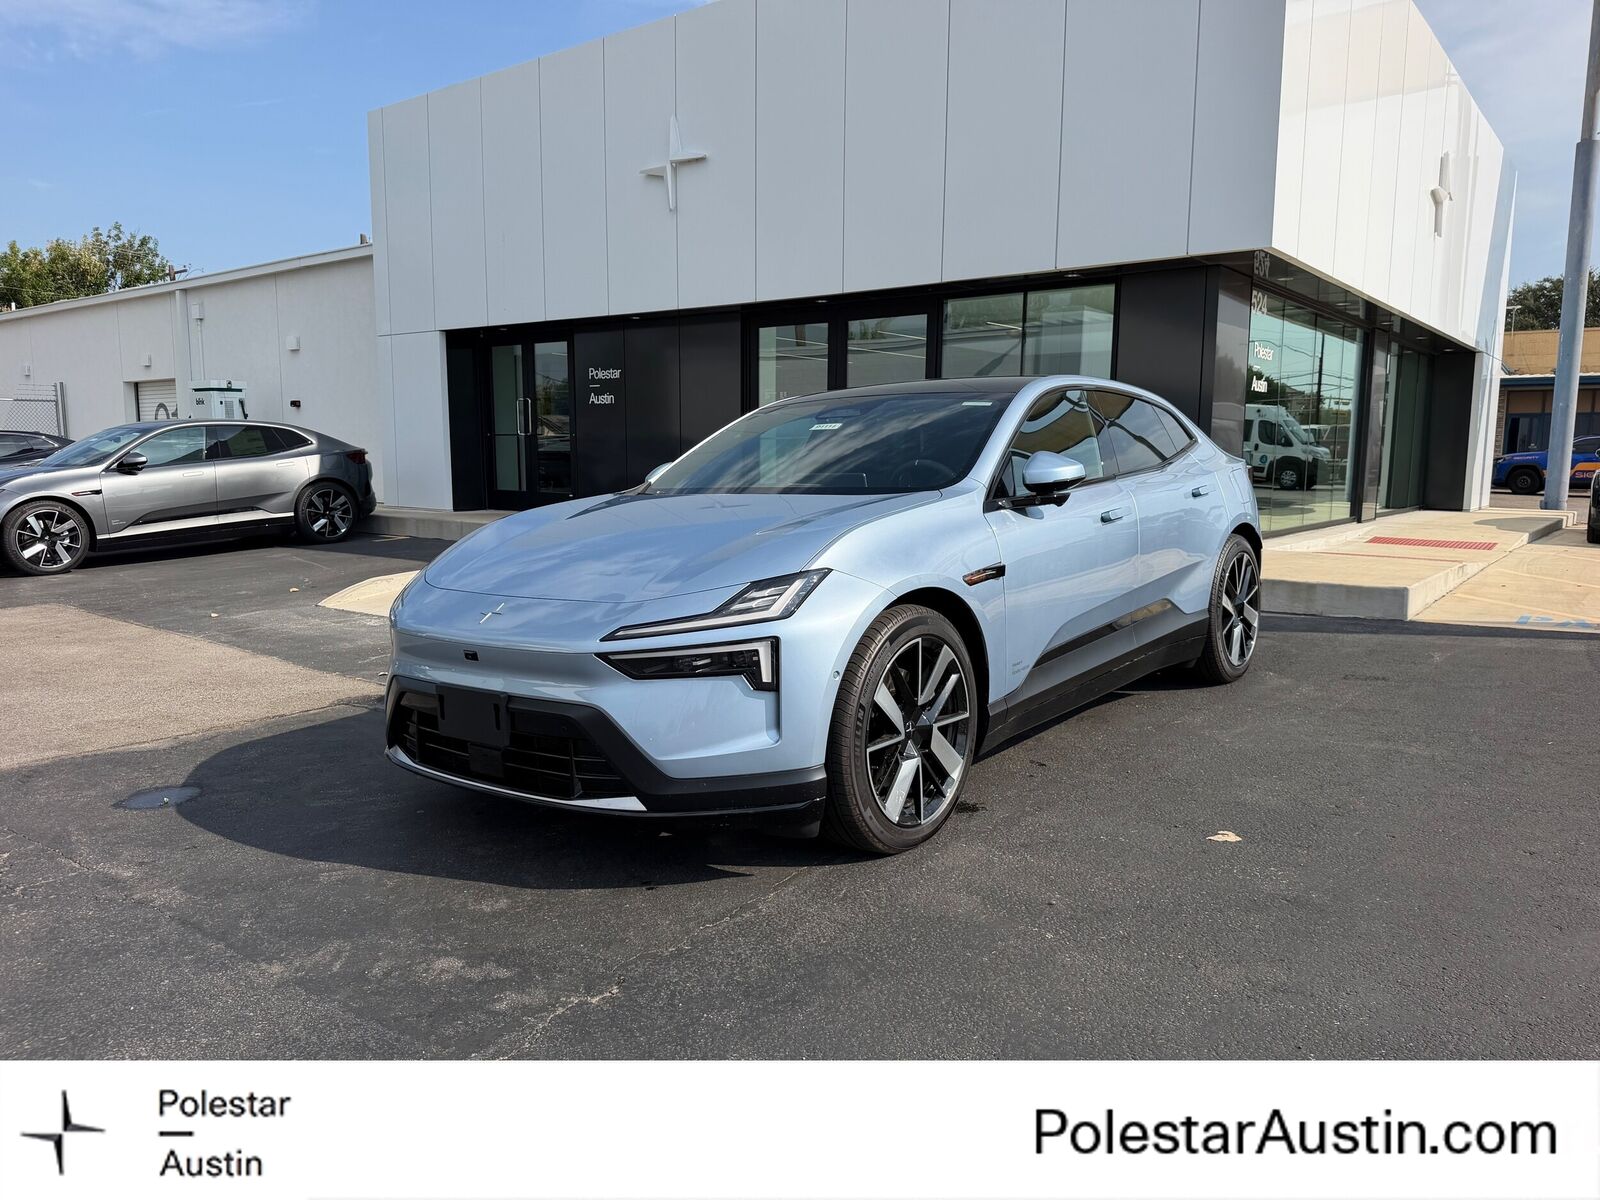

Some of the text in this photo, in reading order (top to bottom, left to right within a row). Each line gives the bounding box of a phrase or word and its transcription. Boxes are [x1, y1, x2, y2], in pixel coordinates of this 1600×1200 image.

[1251, 290, 1268, 315] 524
[1254, 341, 1274, 361] Polestar
[588, 367, 622, 380] Polestar
[1251, 375, 1268, 393] Austin
[588, 392, 615, 405] Austin
